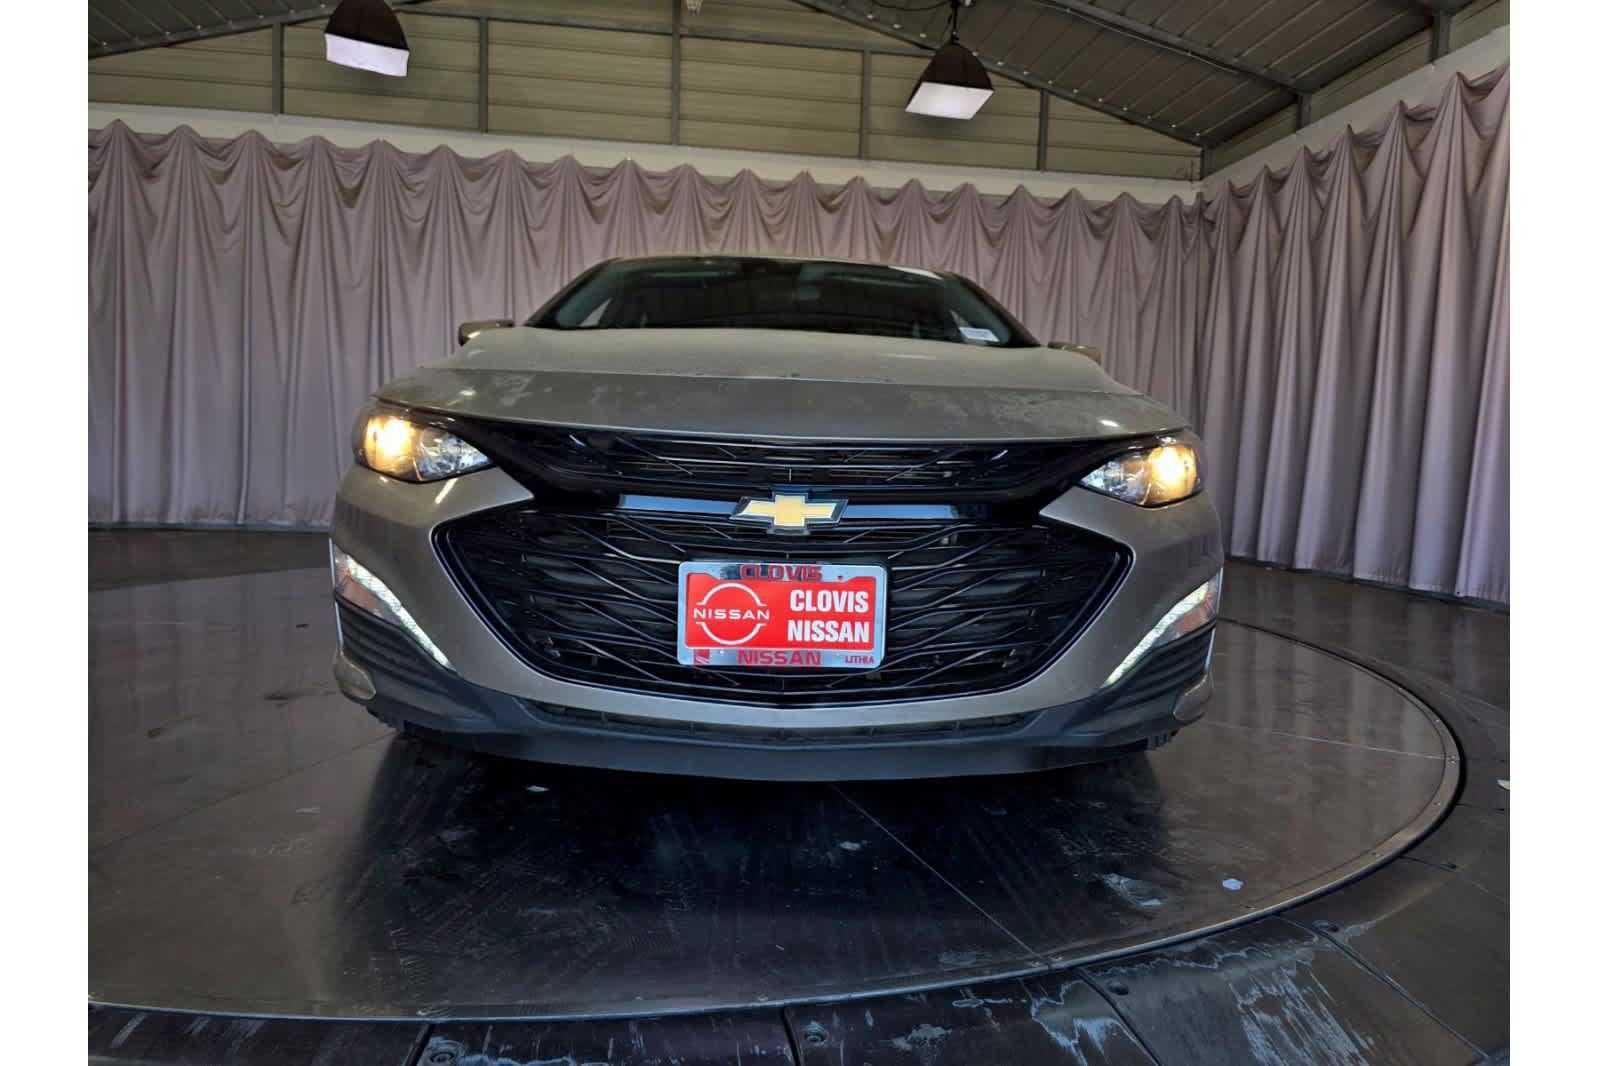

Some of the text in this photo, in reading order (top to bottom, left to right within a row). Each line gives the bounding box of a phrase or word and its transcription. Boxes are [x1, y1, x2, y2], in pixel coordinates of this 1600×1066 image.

[740, 564, 823, 581] CLOVIS
[790, 590, 869, 613] CLOVIS
[693, 607, 770, 620] NISSAN
[787, 620, 869, 643] NISSAN
[737, 650, 821, 666] NISSAN
[844, 655, 874, 664] LITHIA
